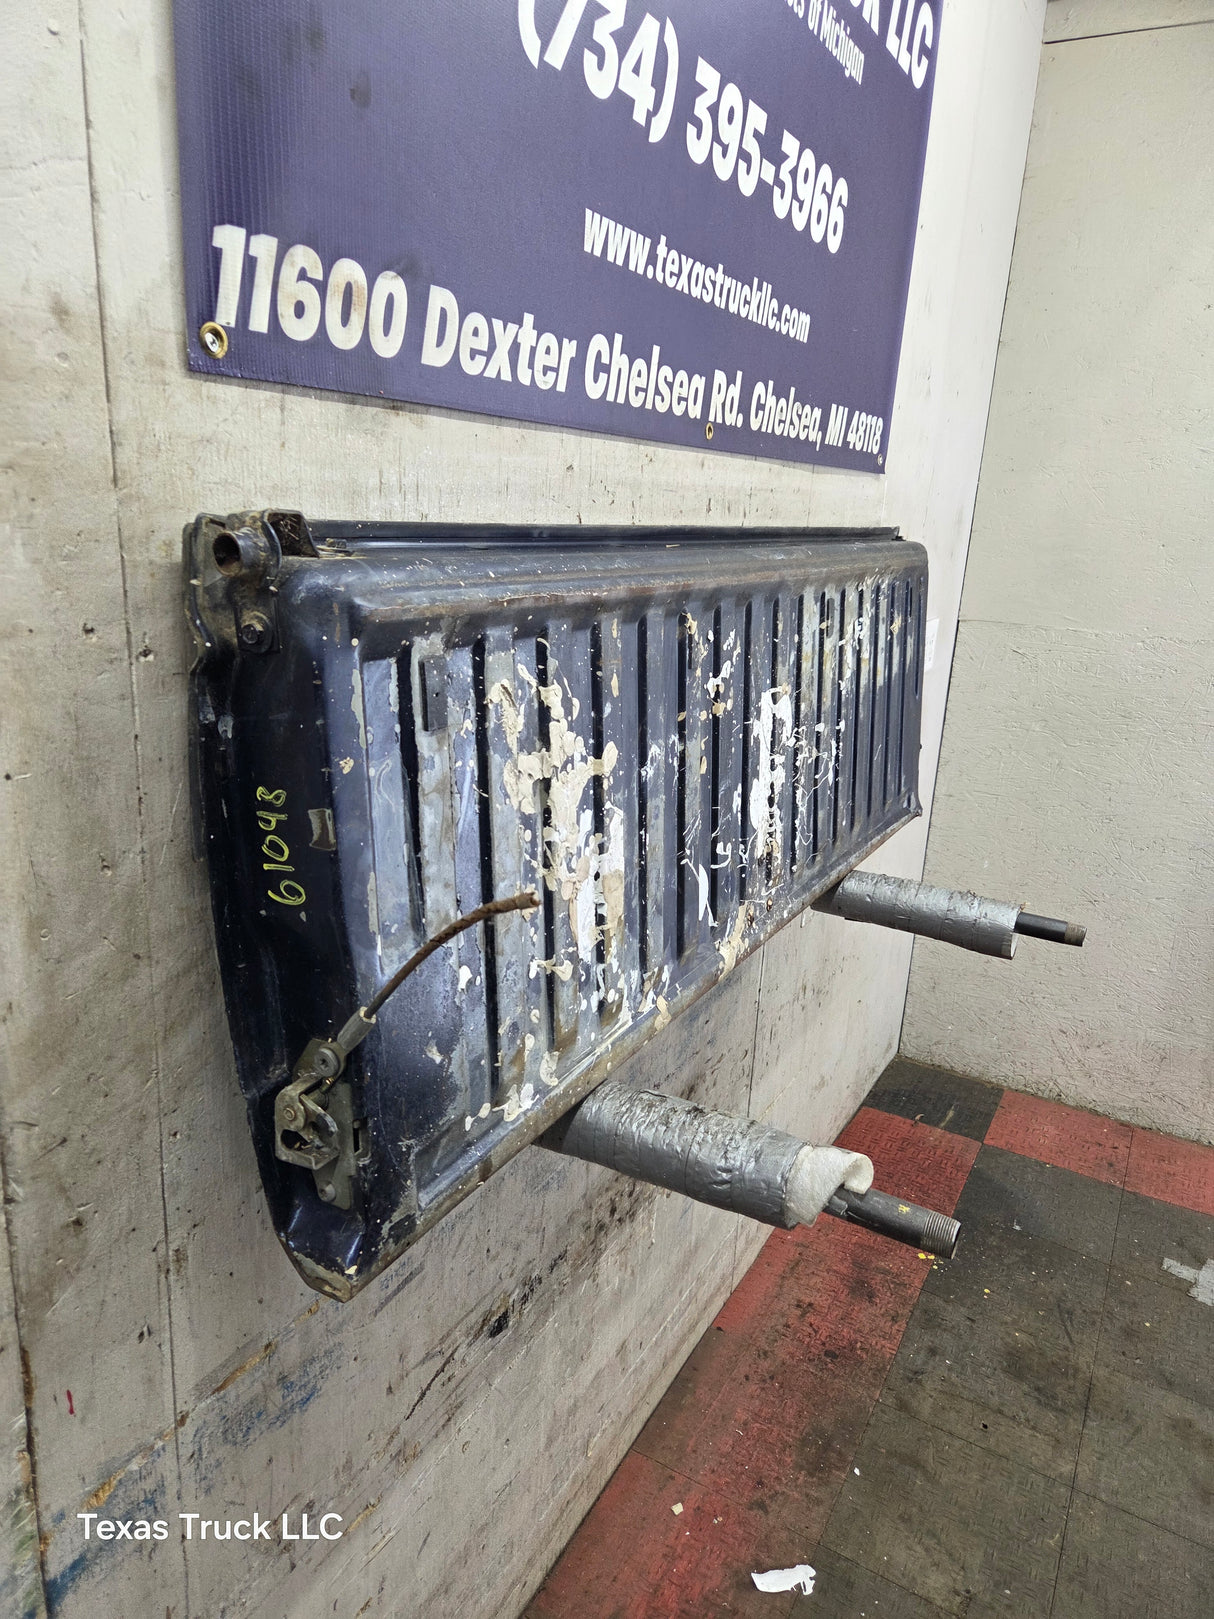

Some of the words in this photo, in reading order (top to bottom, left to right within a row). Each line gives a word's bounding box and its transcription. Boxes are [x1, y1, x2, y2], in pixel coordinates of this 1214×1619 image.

[807, 0, 823, 36] of
[819, 0, 865, 86] Michigan
[885, 0, 934, 90] LLC
[686, 56, 849, 254] 395-3966
[211, 223, 408, 359] 11600
[421, 284, 578, 394] Dexter
[584, 332, 706, 420] Chelsea
[708, 369, 744, 429] Rd.
[749, 380, 823, 452] Chelsea,
[824, 403, 849, 448] MI
[846, 410, 884, 455] 48118
[583, 207, 812, 344] www.texastruckllc.com
